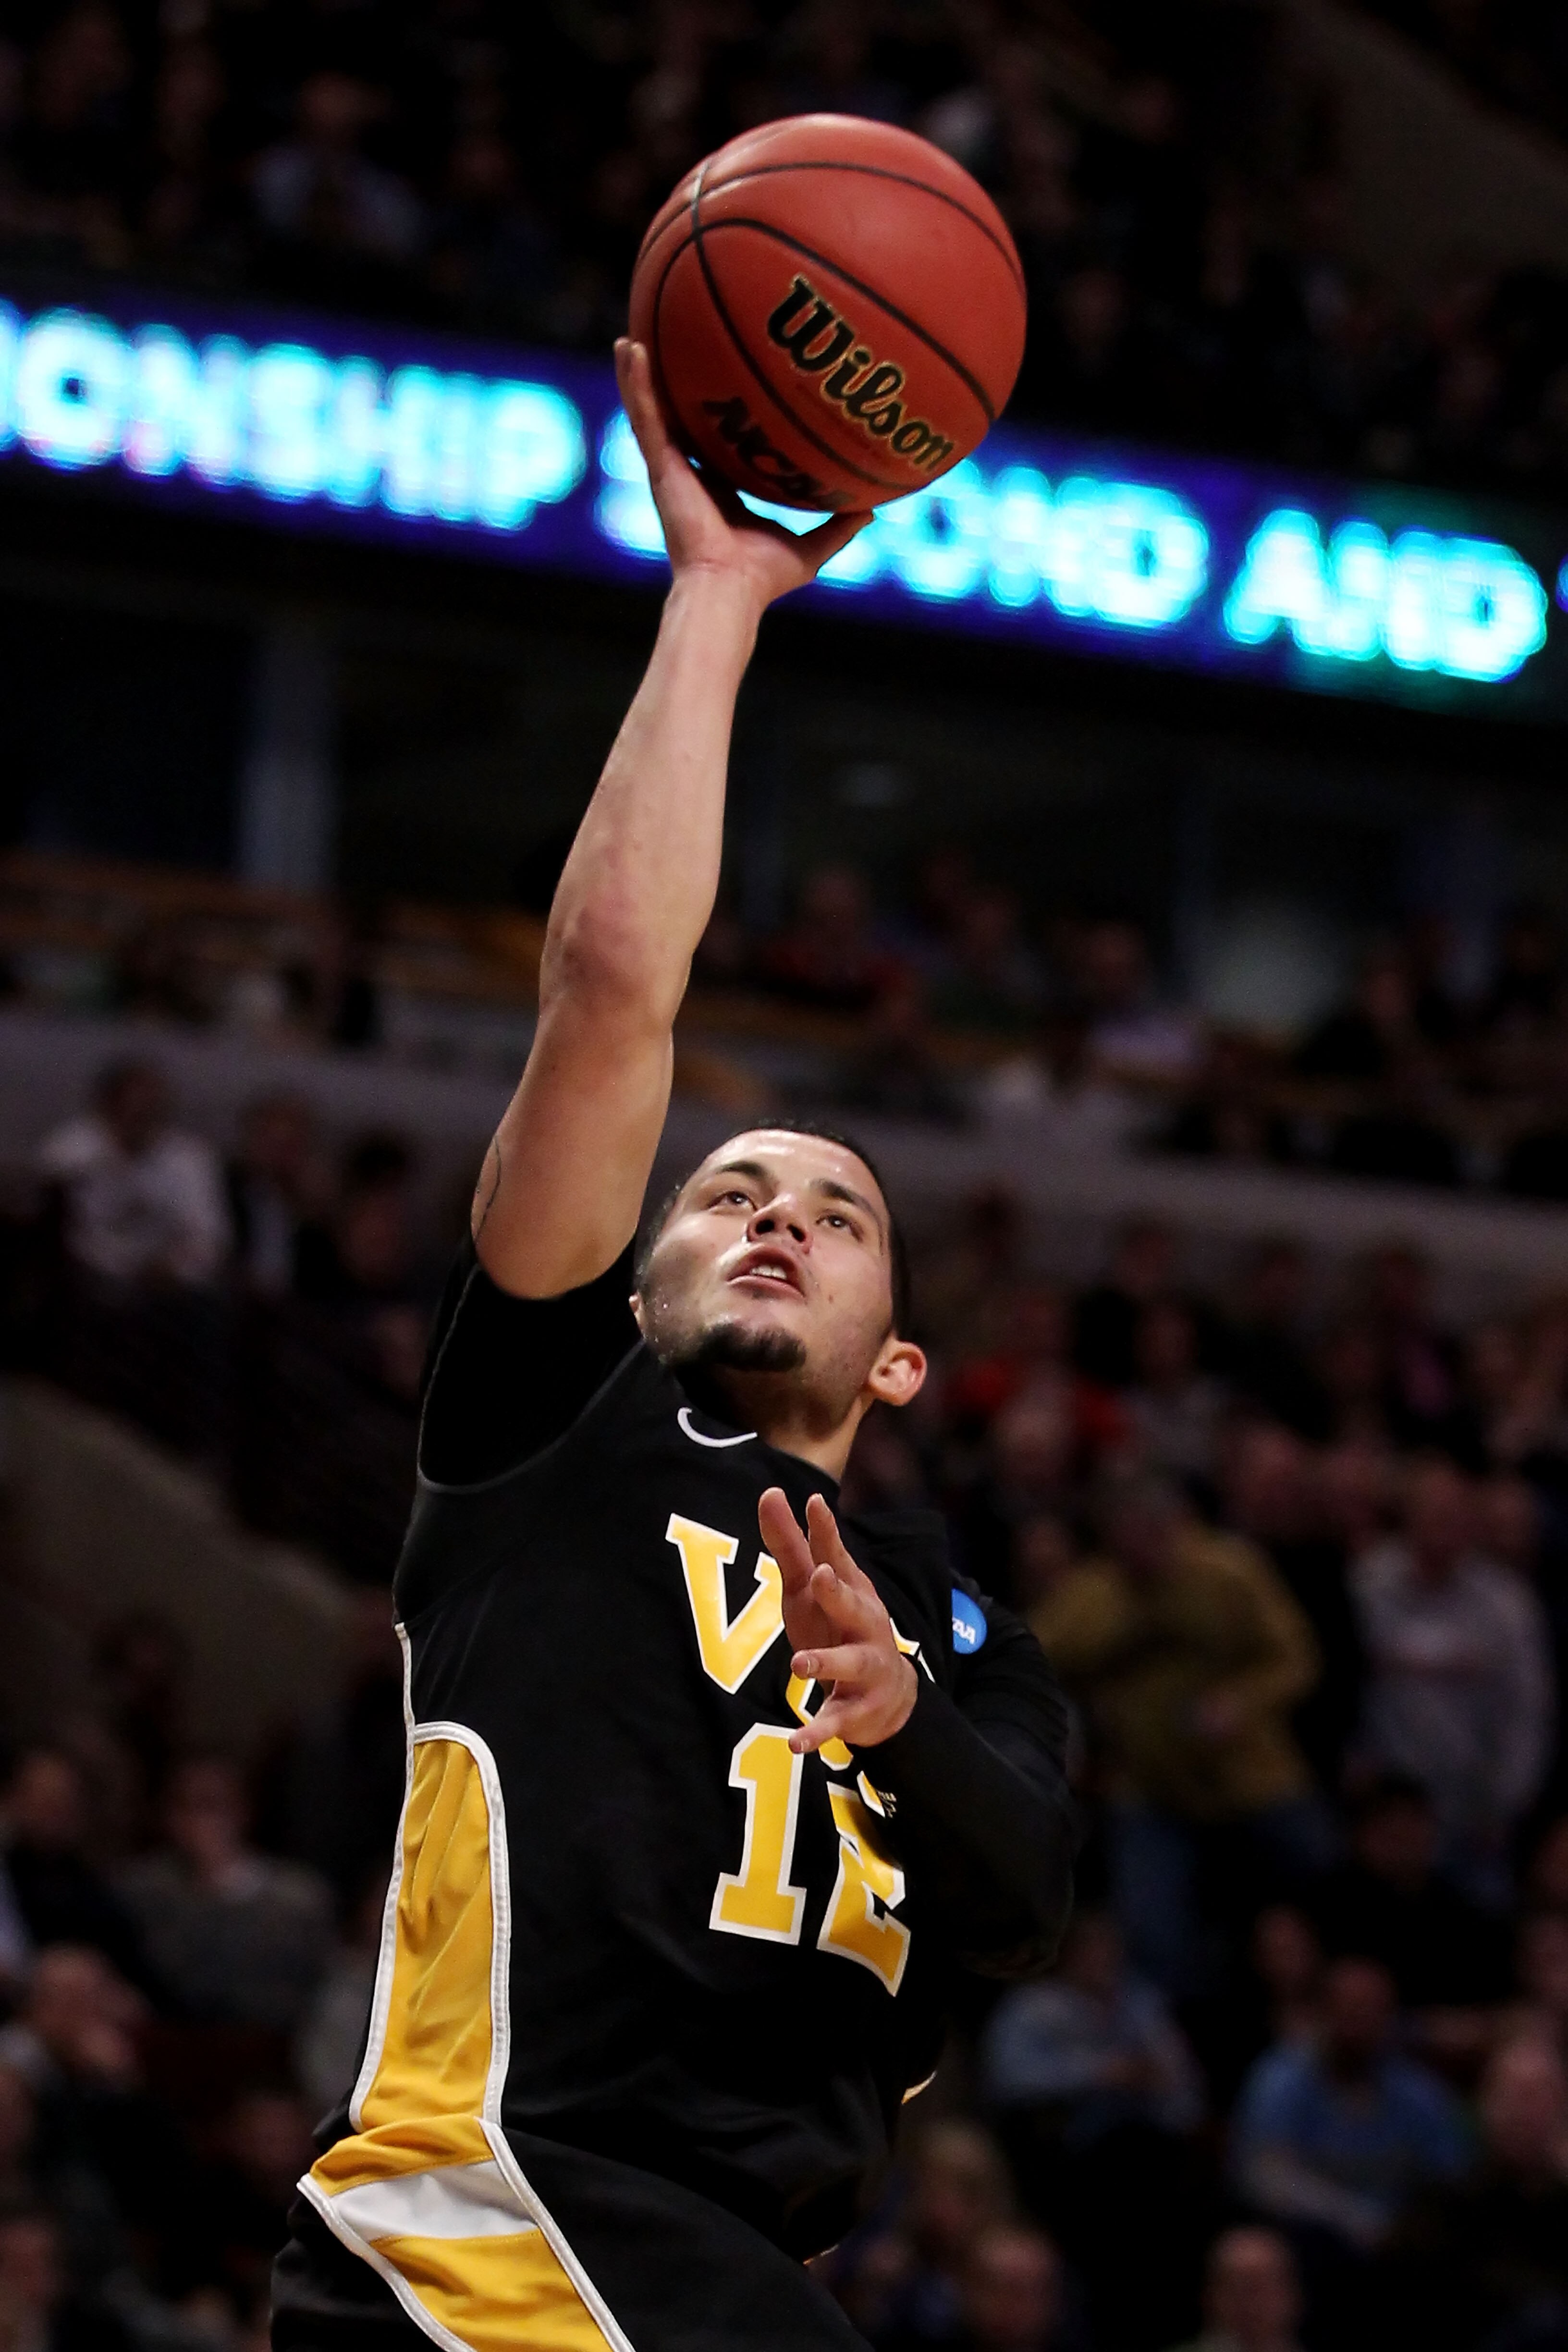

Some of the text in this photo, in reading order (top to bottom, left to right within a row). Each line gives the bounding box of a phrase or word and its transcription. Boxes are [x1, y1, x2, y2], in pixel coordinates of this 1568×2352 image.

[767, 272, 954, 473] Wilson
[1224, 509, 1547, 682] AND
[710, 1723, 911, 1997] 12
